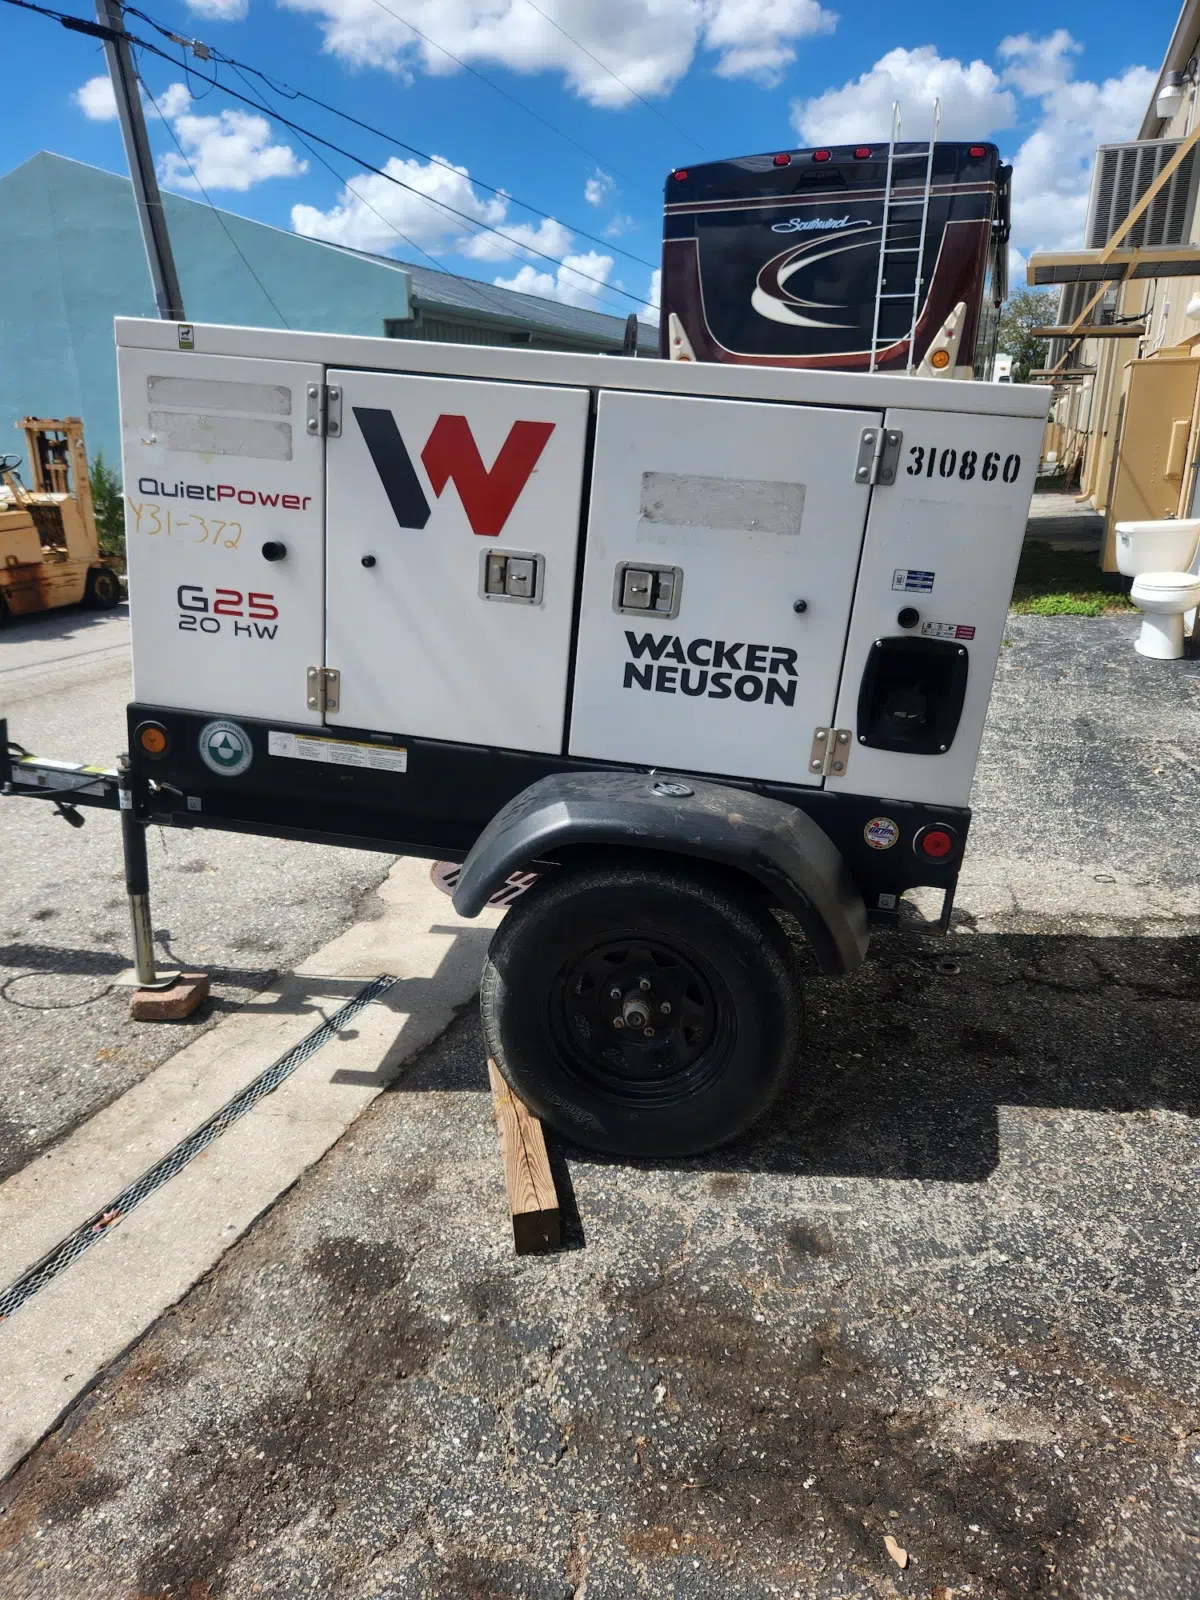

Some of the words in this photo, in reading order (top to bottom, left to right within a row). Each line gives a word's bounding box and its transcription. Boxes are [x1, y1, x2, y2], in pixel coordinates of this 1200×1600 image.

[771, 215, 872, 233] Southwind
[906, 446, 1021, 483] 310860
[138, 477, 312, 510] QuietPower
[127, 496, 242, 549] Y31-372
[177, 584, 279, 620] G25
[178, 614, 221, 634] 20
[624, 630, 799, 677] WACKER
[622, 661, 798, 707] NEUSON
